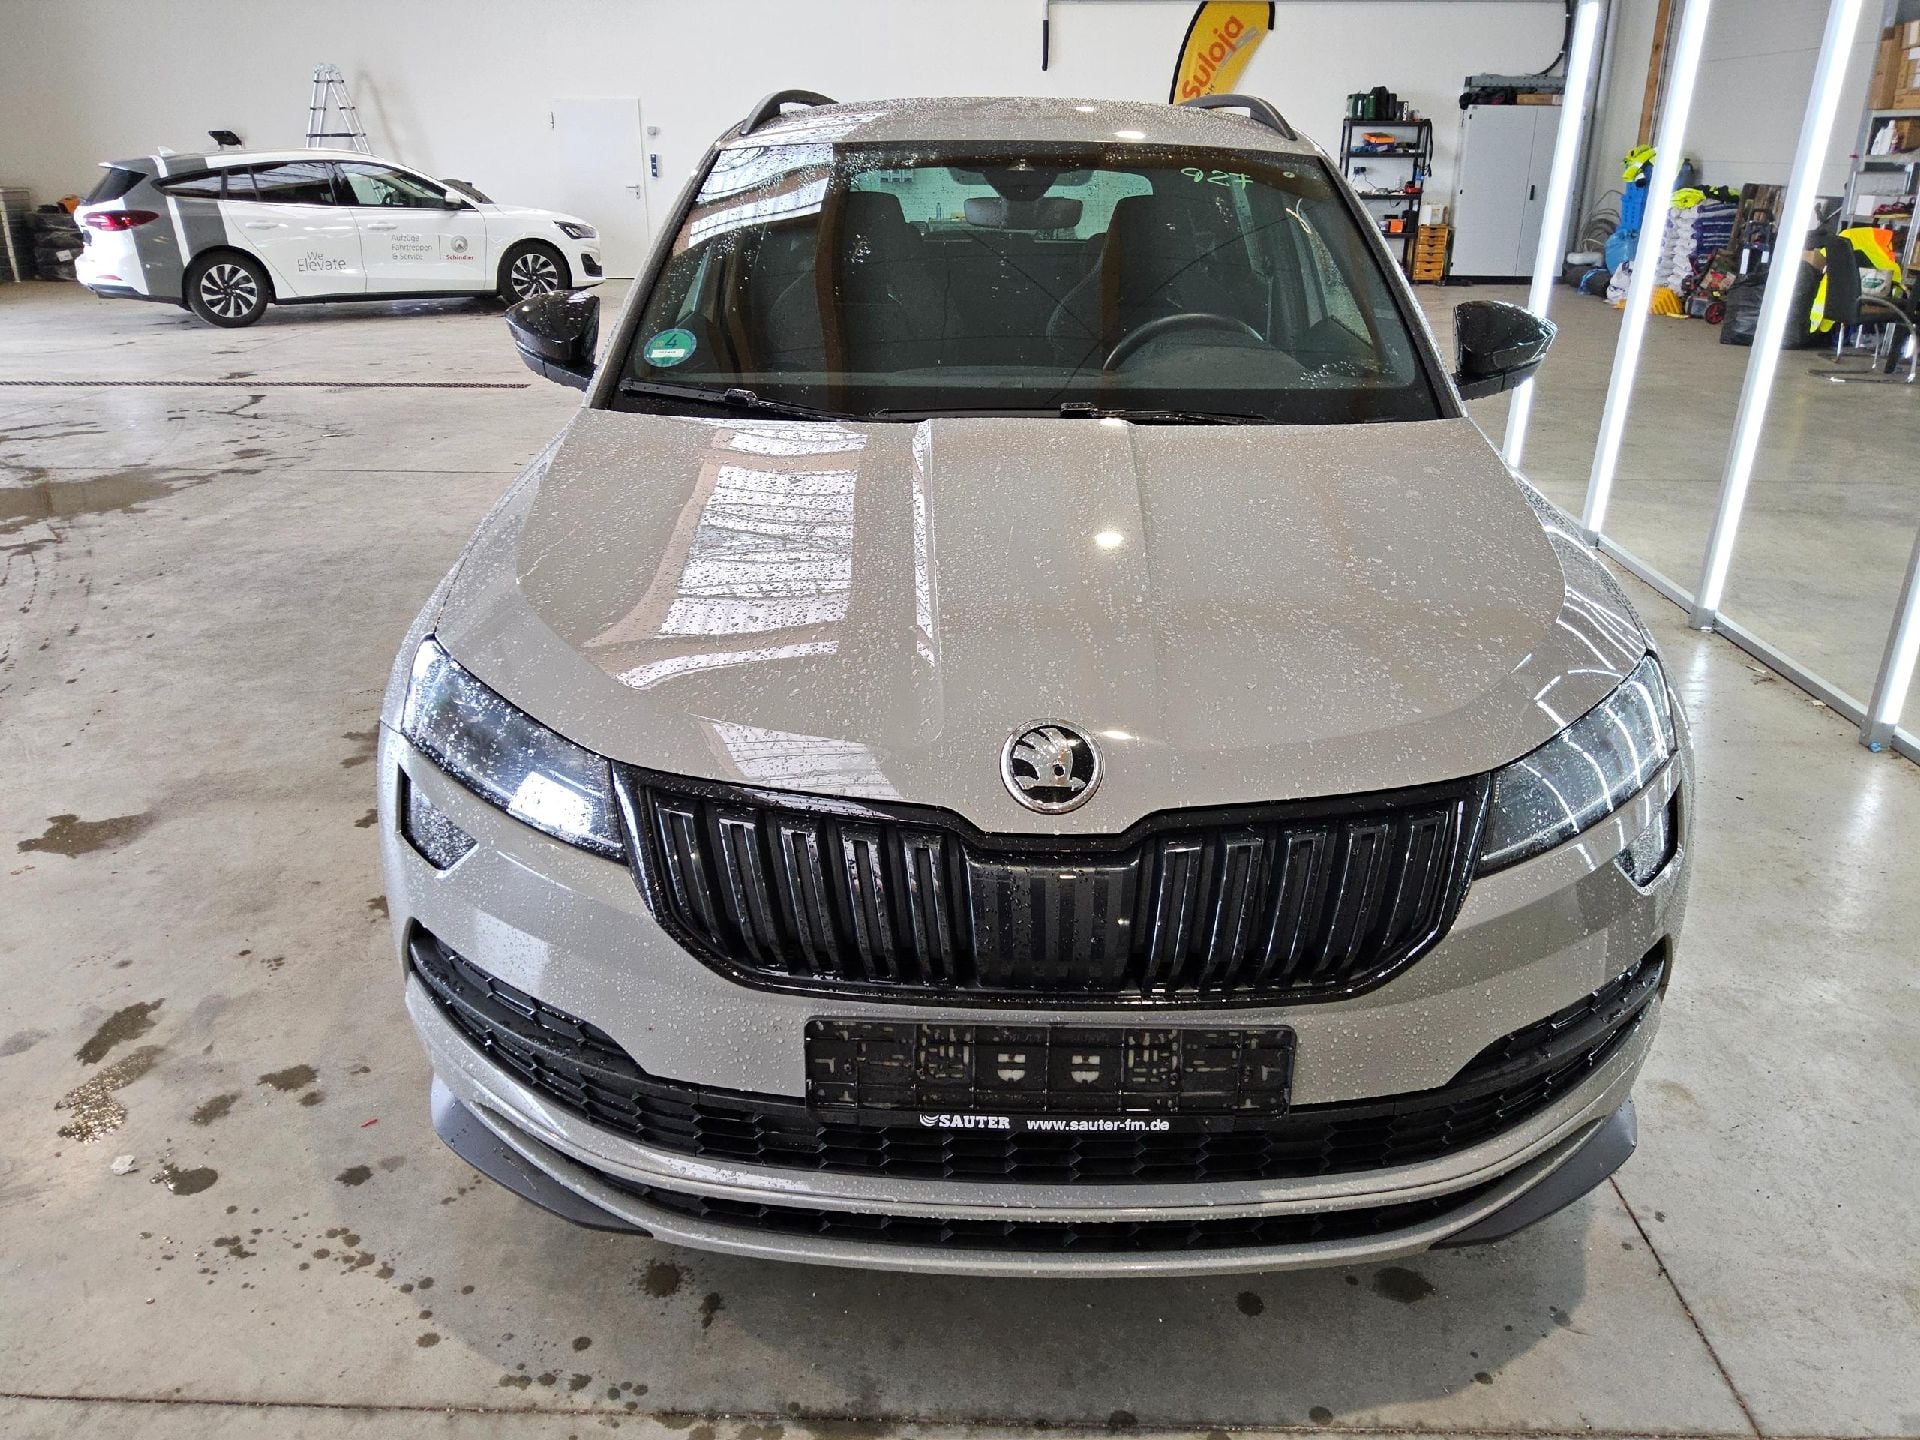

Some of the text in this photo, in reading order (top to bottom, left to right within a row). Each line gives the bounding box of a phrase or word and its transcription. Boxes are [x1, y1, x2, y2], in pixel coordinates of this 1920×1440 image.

[1182, 15, 1244, 98] Suloja
[306, 249, 324, 261] We
[297, 258, 347, 272] Elevate
[664, 333, 678, 348] 4
[938, 1114, 1170, 1131] SAUTER www.sauter-fm.de
